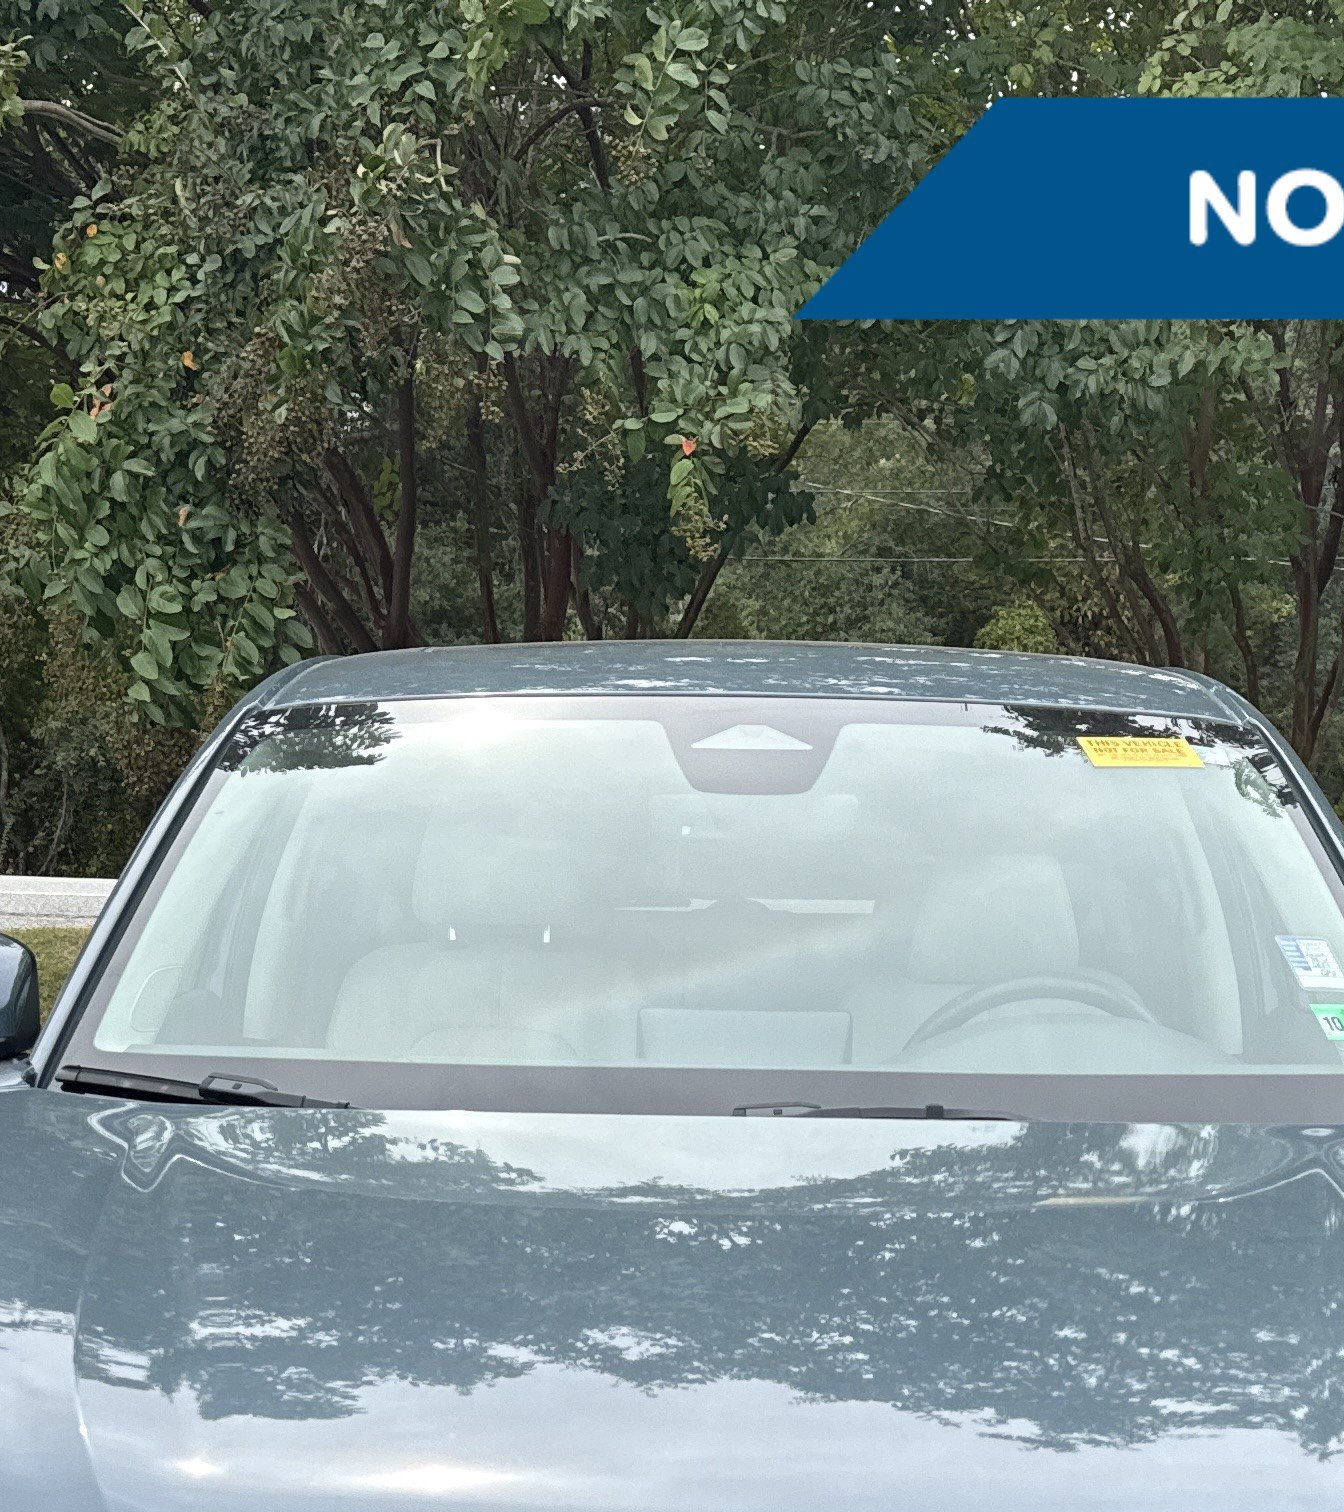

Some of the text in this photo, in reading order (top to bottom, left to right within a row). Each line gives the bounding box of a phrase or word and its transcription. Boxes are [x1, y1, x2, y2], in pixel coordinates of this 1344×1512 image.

[1086, 739, 1185, 748] THIS VEHICLE
[1323, 1016, 1344, 1032] 10
